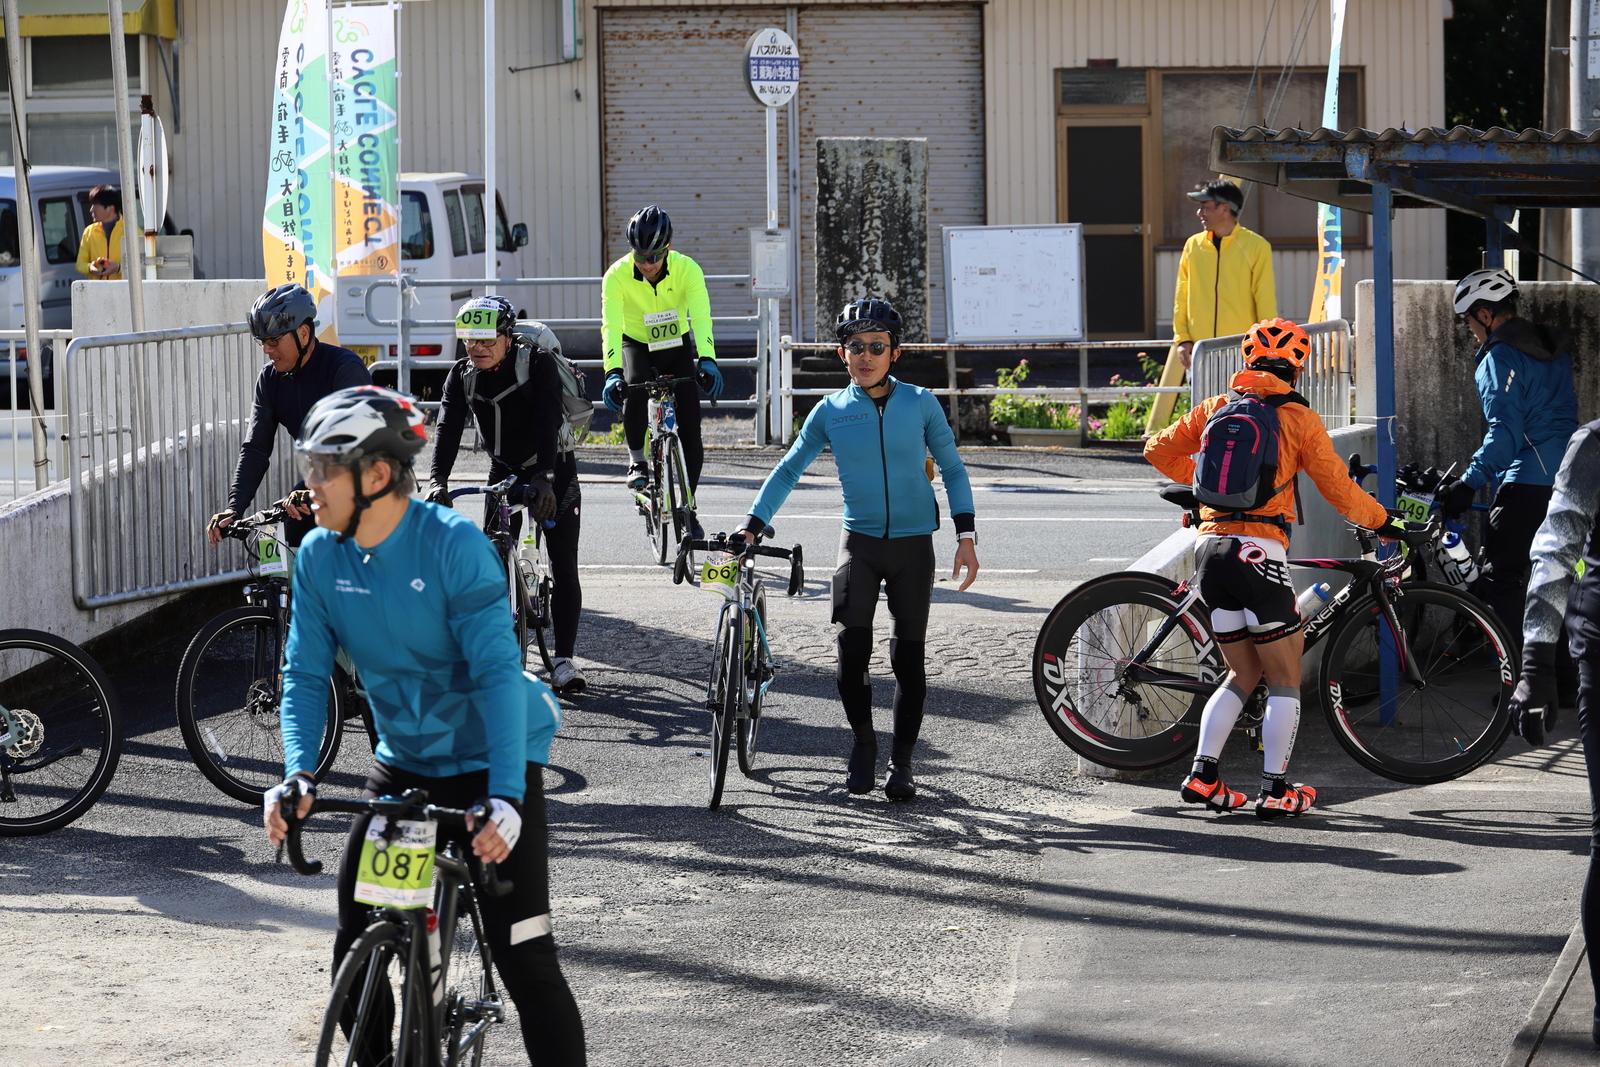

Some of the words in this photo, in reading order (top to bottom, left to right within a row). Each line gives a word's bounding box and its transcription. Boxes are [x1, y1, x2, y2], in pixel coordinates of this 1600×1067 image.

[756, 45, 793, 55] バスのりば
[759, 85, 791, 95] あいなんバス
[461, 310, 492, 325] 051
[651, 323, 678, 339] 070
[1397, 499, 1425, 520] 049
[707, 565, 738, 584] 062
[372, 849, 429, 881] 087
